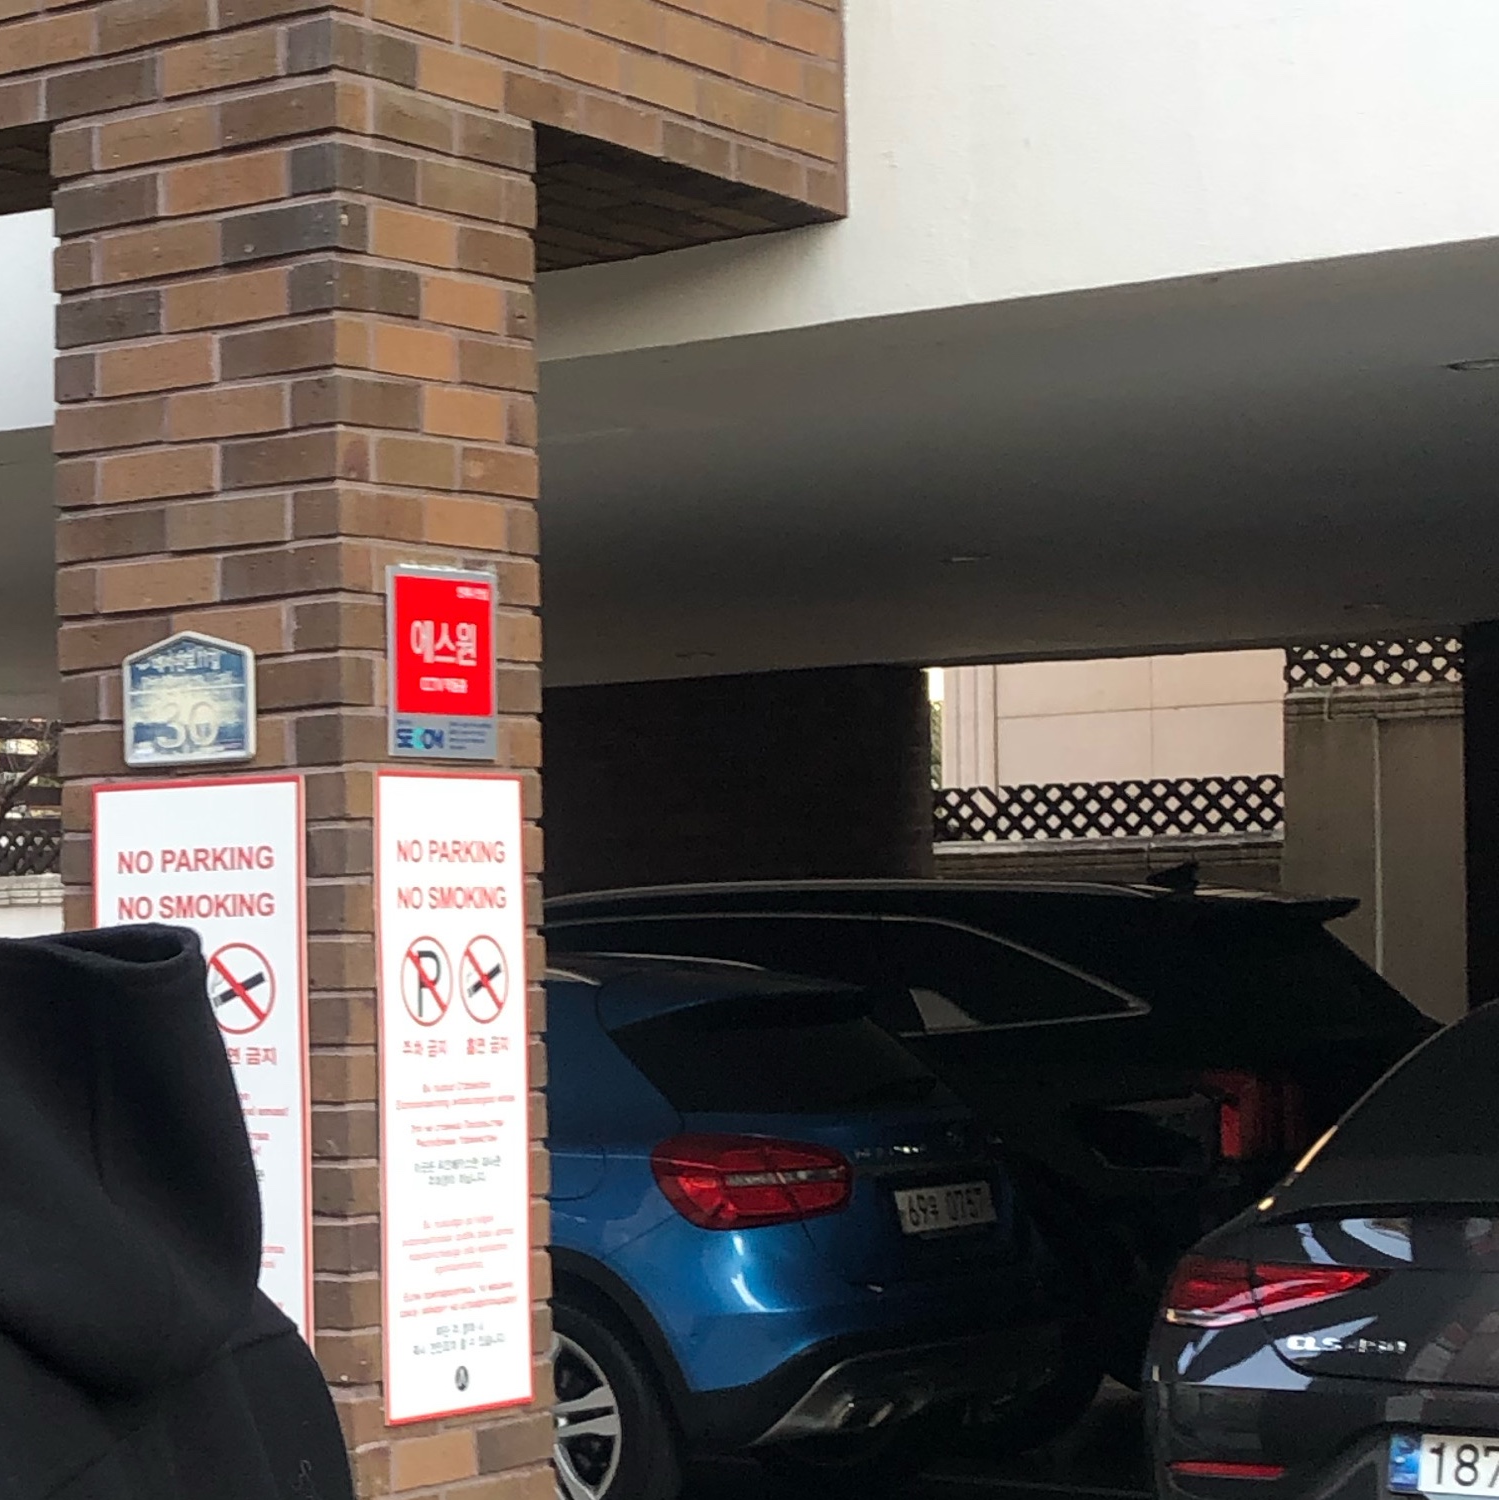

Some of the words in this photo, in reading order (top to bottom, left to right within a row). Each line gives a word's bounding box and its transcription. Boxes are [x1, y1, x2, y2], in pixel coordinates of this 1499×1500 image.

[410, 619, 477, 667] 에스원
[117, 849, 154, 875] NO
[160, 845, 275, 873] PARKING
[396, 839, 423, 863] NO
[428, 839, 506, 863] PARKING
[117, 896, 154, 921] NO
[158, 892, 275, 920] SMOKING
[397, 886, 424, 910] NO
[428, 886, 507, 910] SMOKING
[226, 1046, 241, 1065] 연
[245, 1046, 278, 1066] 금지
[1430, 1441, 1499, 1488] 187
